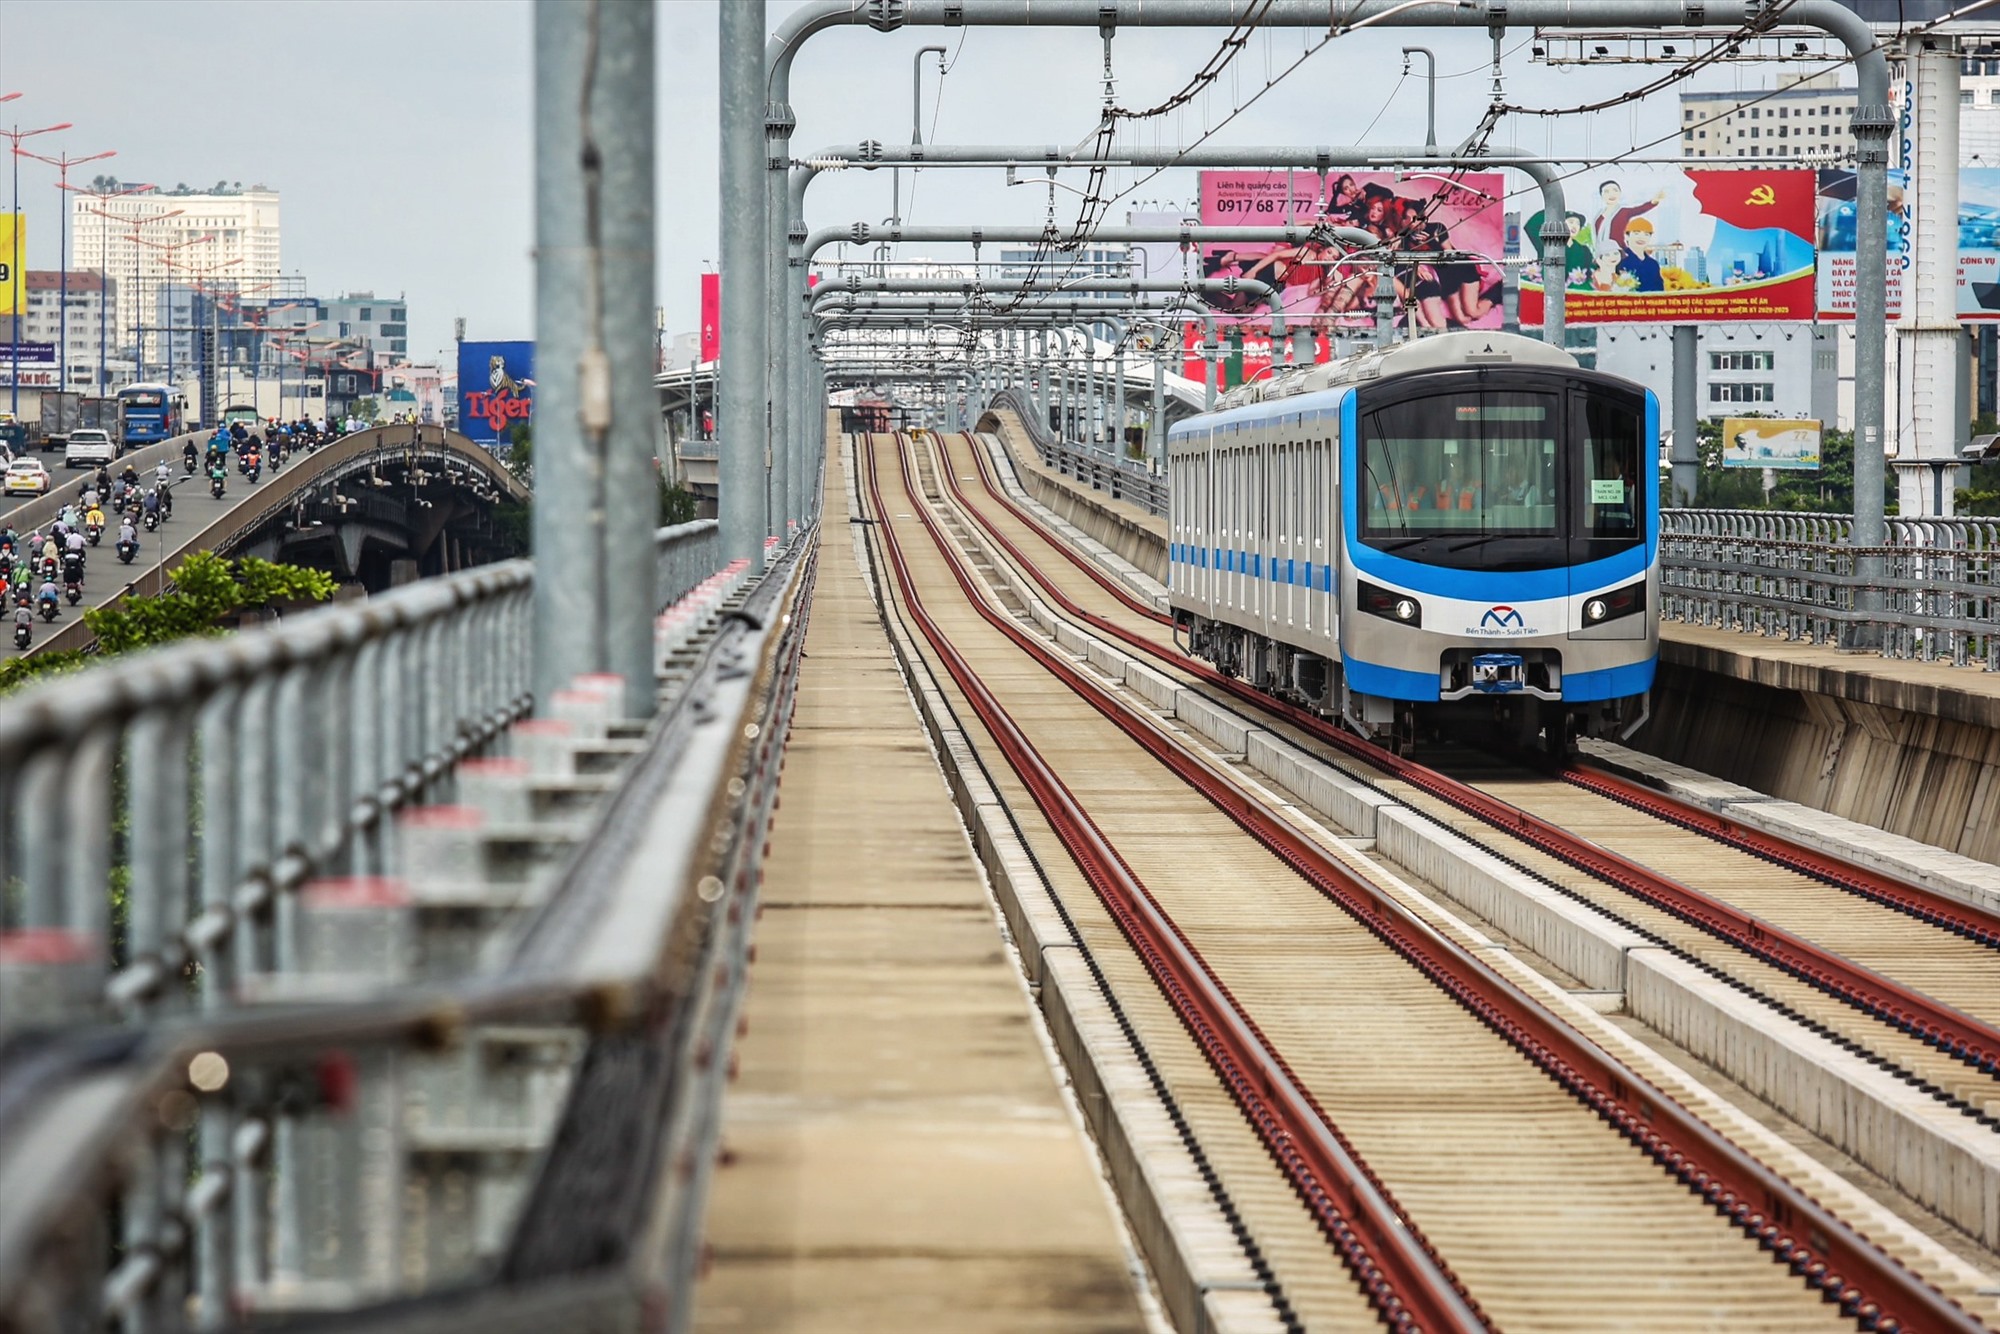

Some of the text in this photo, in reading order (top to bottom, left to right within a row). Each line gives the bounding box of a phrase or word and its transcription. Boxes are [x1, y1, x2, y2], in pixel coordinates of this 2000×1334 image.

[1217, 181, 1234, 189] Liên
[1236, 181, 1245, 190] hệ
[1247, 181, 1271, 191] quảng
[1217, 191, 1252, 199] Advertising
[1217, 199, 1312, 212] 0917 68 777
[465, 388, 532, 431] Tiger
